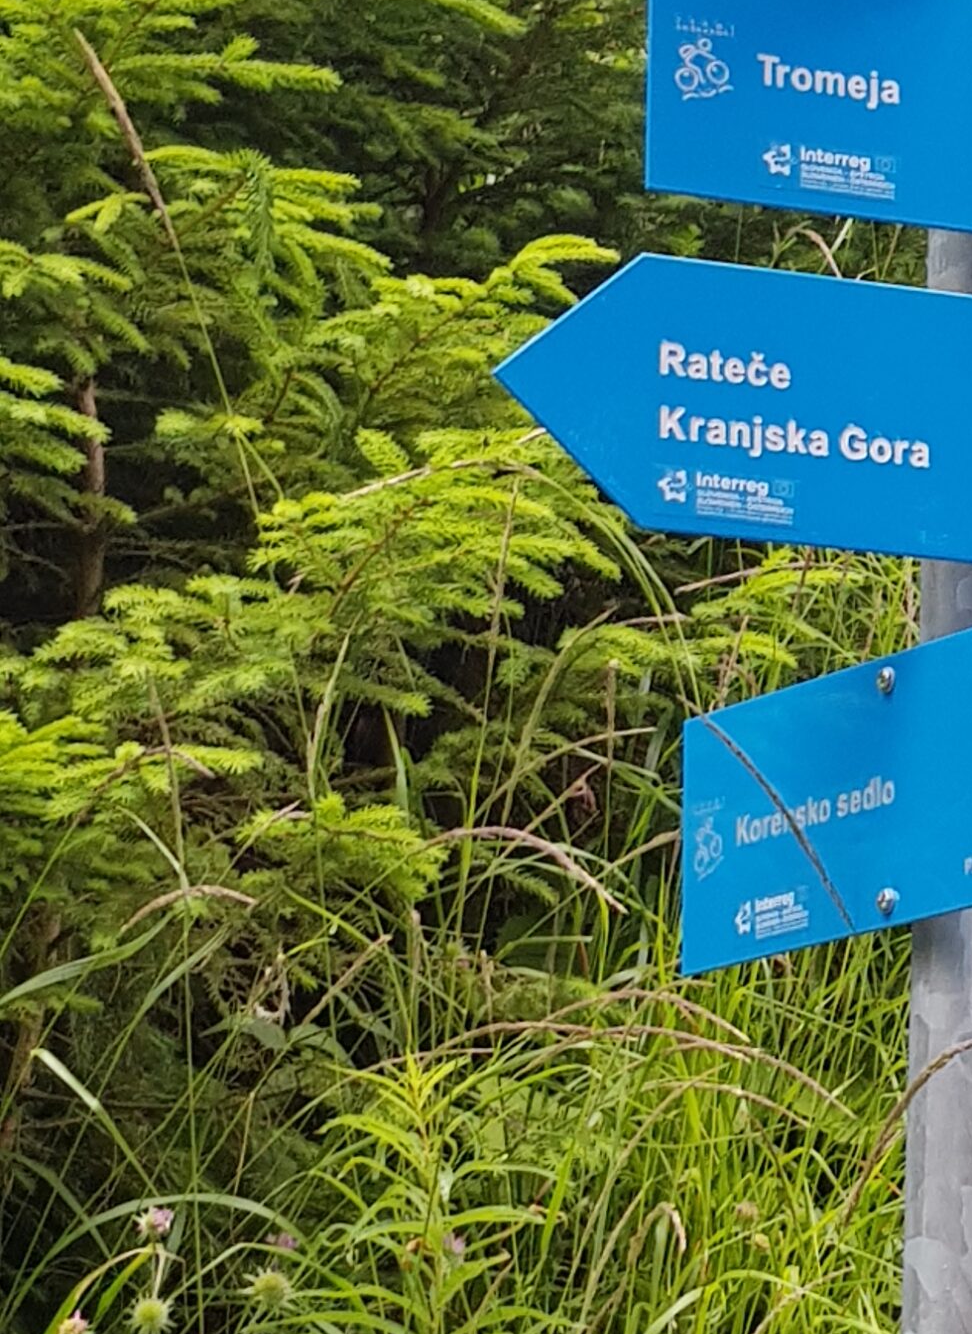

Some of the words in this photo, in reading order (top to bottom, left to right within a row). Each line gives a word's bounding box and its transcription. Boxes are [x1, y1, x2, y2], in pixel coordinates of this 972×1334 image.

[758, 54, 899, 109] Tromeja
[800, 145, 871, 172] Interreg
[659, 341, 790, 389] Rateče
[658, 405, 830, 457] Kranjska
[839, 424, 929, 467] Gora
[696, 471, 769, 498] Interreg
[837, 777, 894, 817] sedlo
